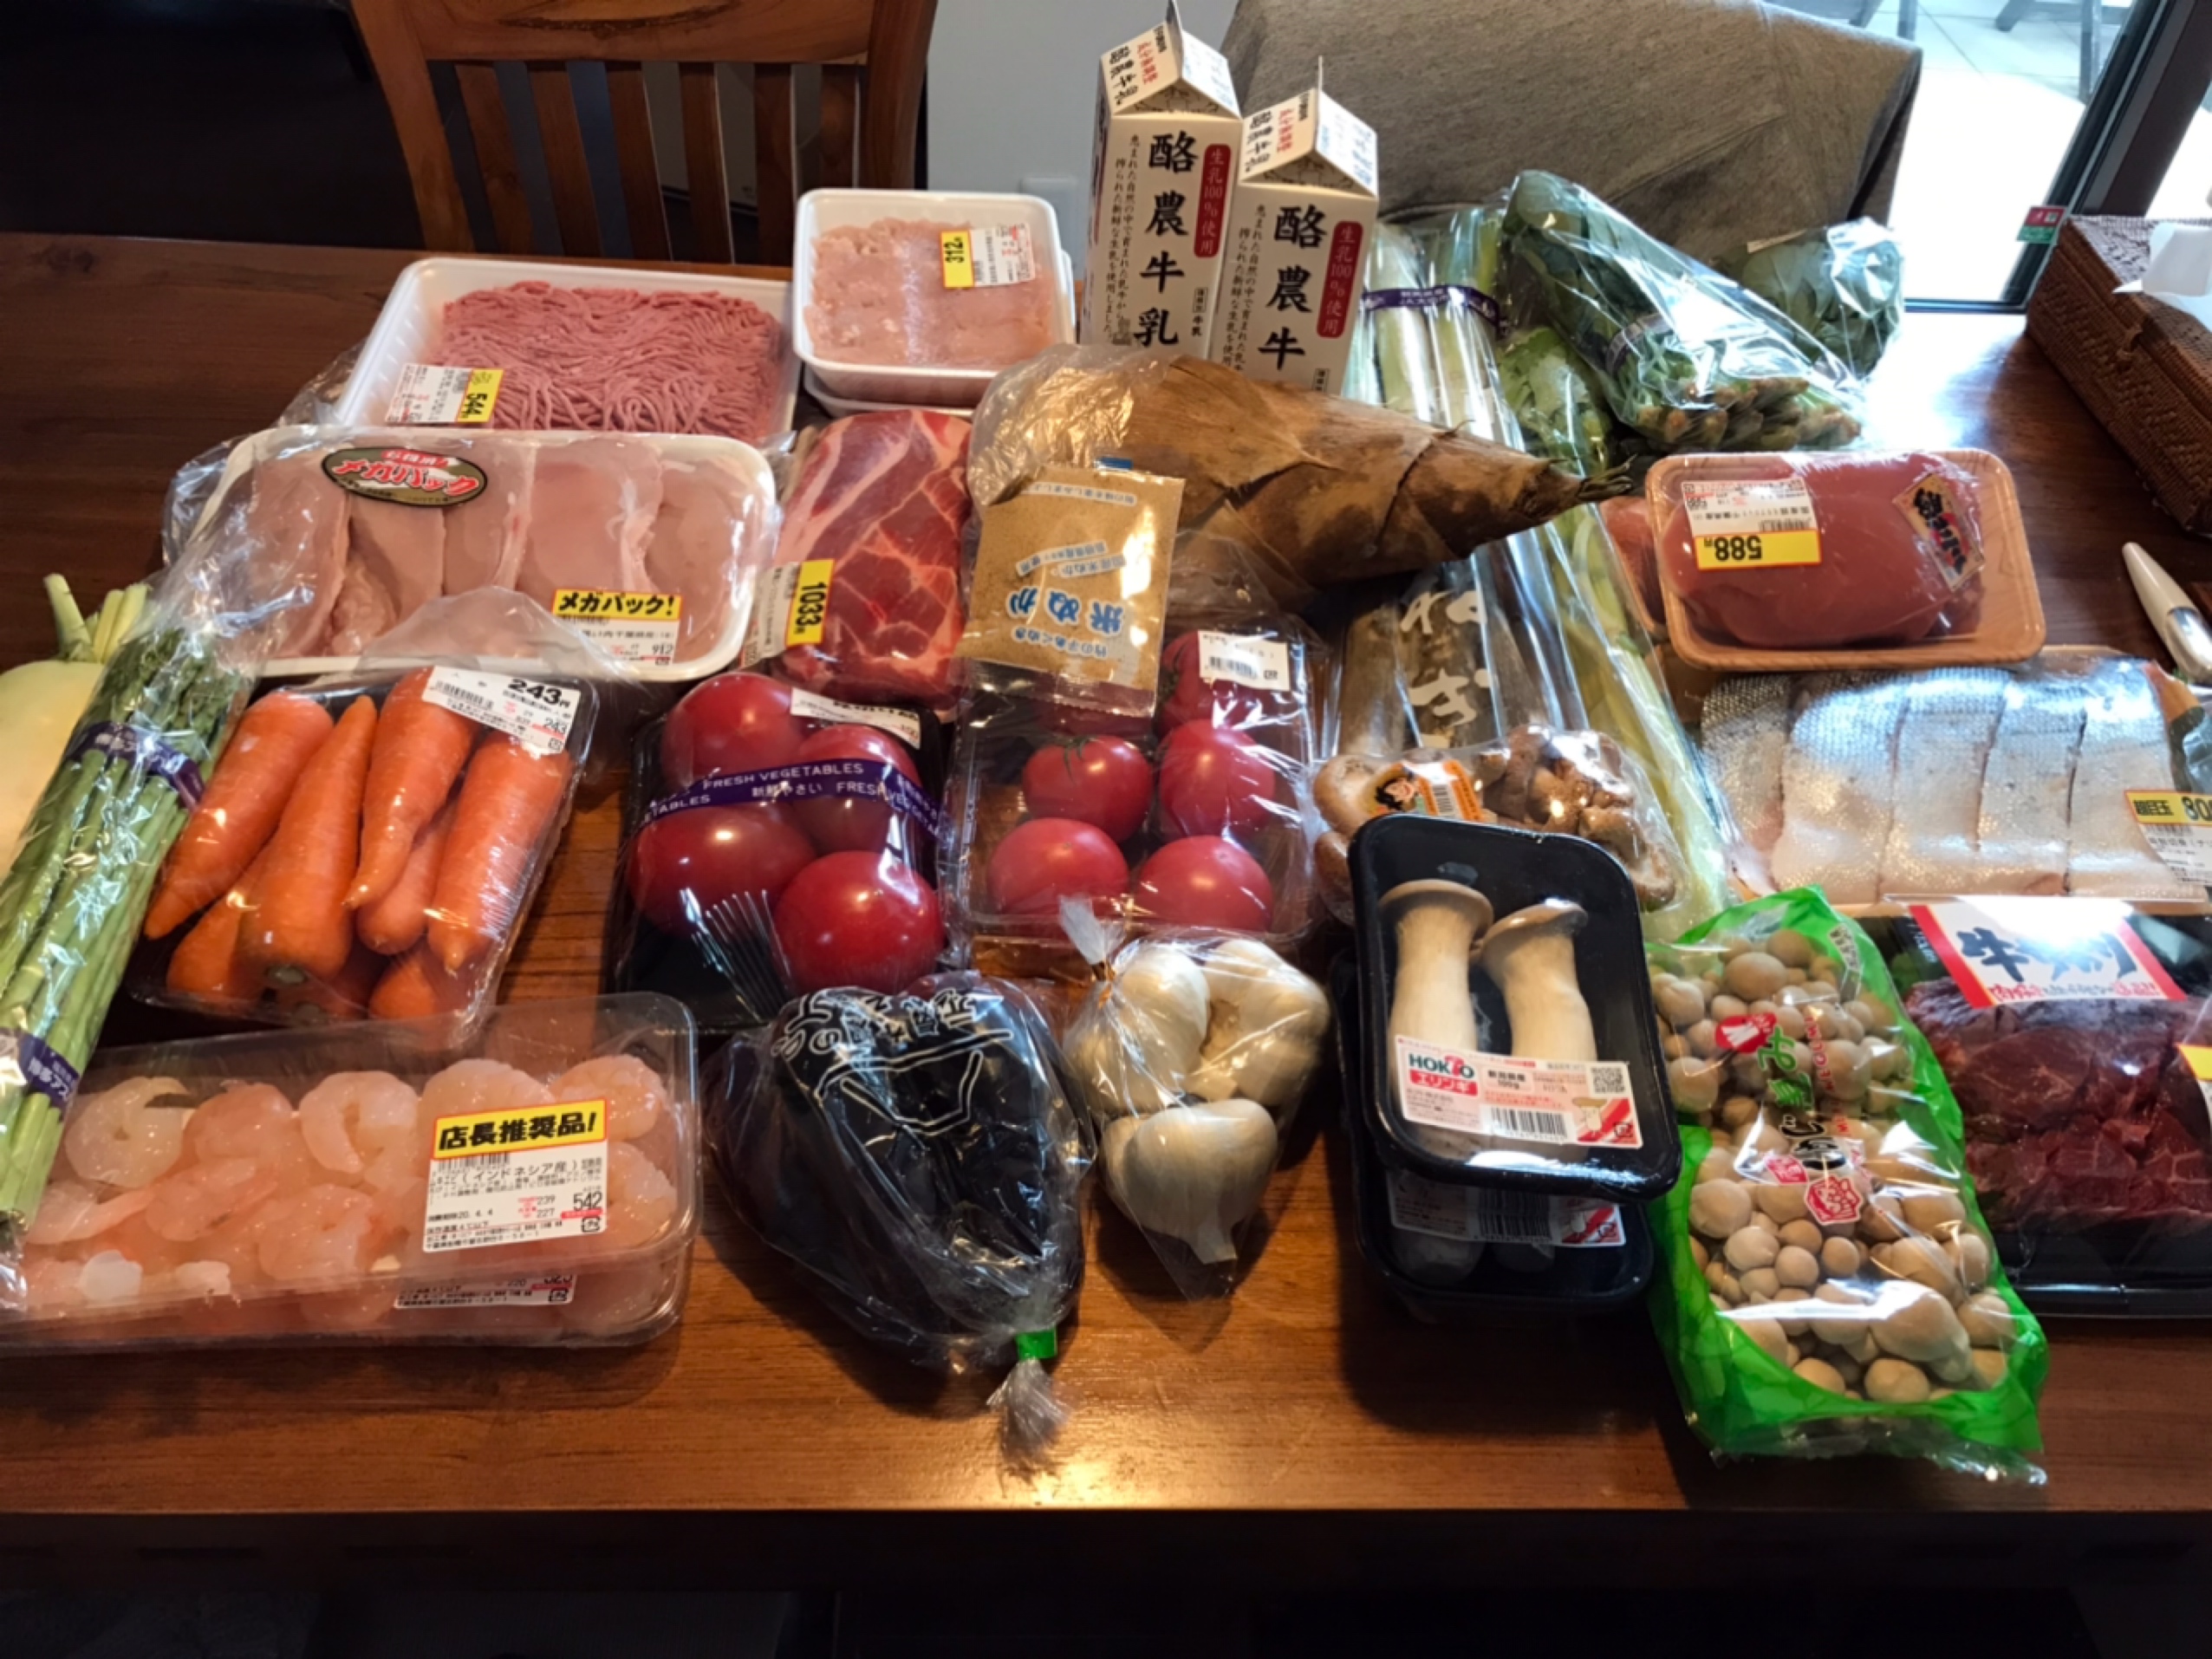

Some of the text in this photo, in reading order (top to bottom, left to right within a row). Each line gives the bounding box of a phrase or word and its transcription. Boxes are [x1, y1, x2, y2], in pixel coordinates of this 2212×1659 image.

[1134, 130, 1200, 348] 酪農牛乳
[1258, 203, 1328, 372] 酪農牛
[333, 458, 479, 497] メガパック
[558, 591, 674, 616] メガパック!
[1009, 587, 1124, 634] 米ぬか
[703, 763, 864, 790] FRESH VEGETABLES
[1409, 1053, 1475, 1079] HOKTO
[438, 1111, 597, 1151] 店長推奨品!
[573, 1190, 603, 1212] 542
